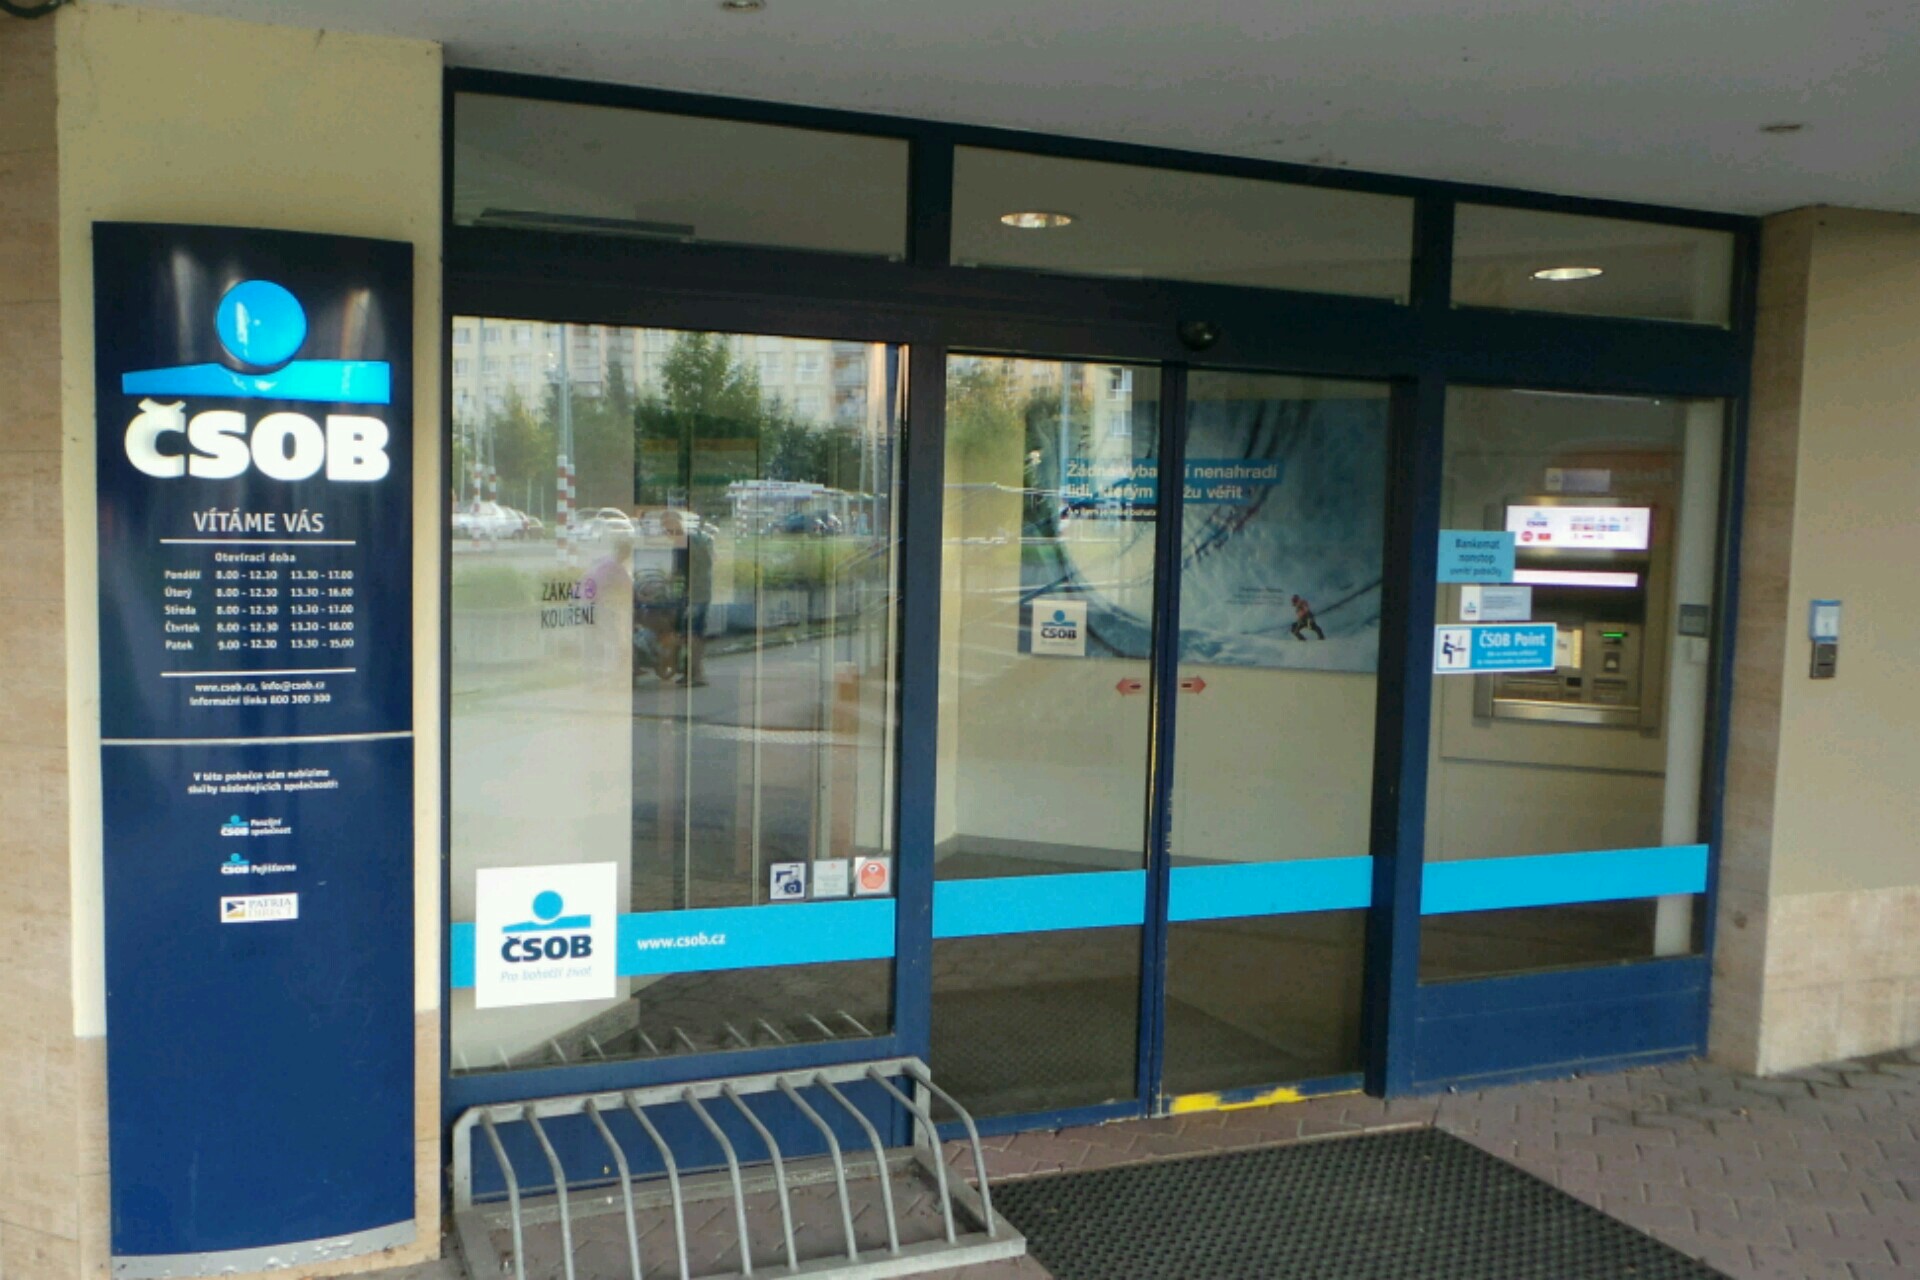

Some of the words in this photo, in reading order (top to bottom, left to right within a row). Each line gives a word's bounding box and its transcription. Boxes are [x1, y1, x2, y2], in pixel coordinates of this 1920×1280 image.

[124, 398, 390, 482] ČSOB
[1194, 463, 1278, 479] nenahradí
[193, 507, 276, 533] VÍTÁME
[284, 509, 325, 533] VÁS
[269, 552, 297, 563] doba
[541, 578, 581, 601] ZÁKAZ
[540, 602, 596, 629] KOUŘENÍ
[1479, 629, 1511, 647] ČSOB
[1514, 631, 1546, 647] Point
[501, 933, 593, 963] ČSOB
[637, 931, 727, 950] www.csob.cz
